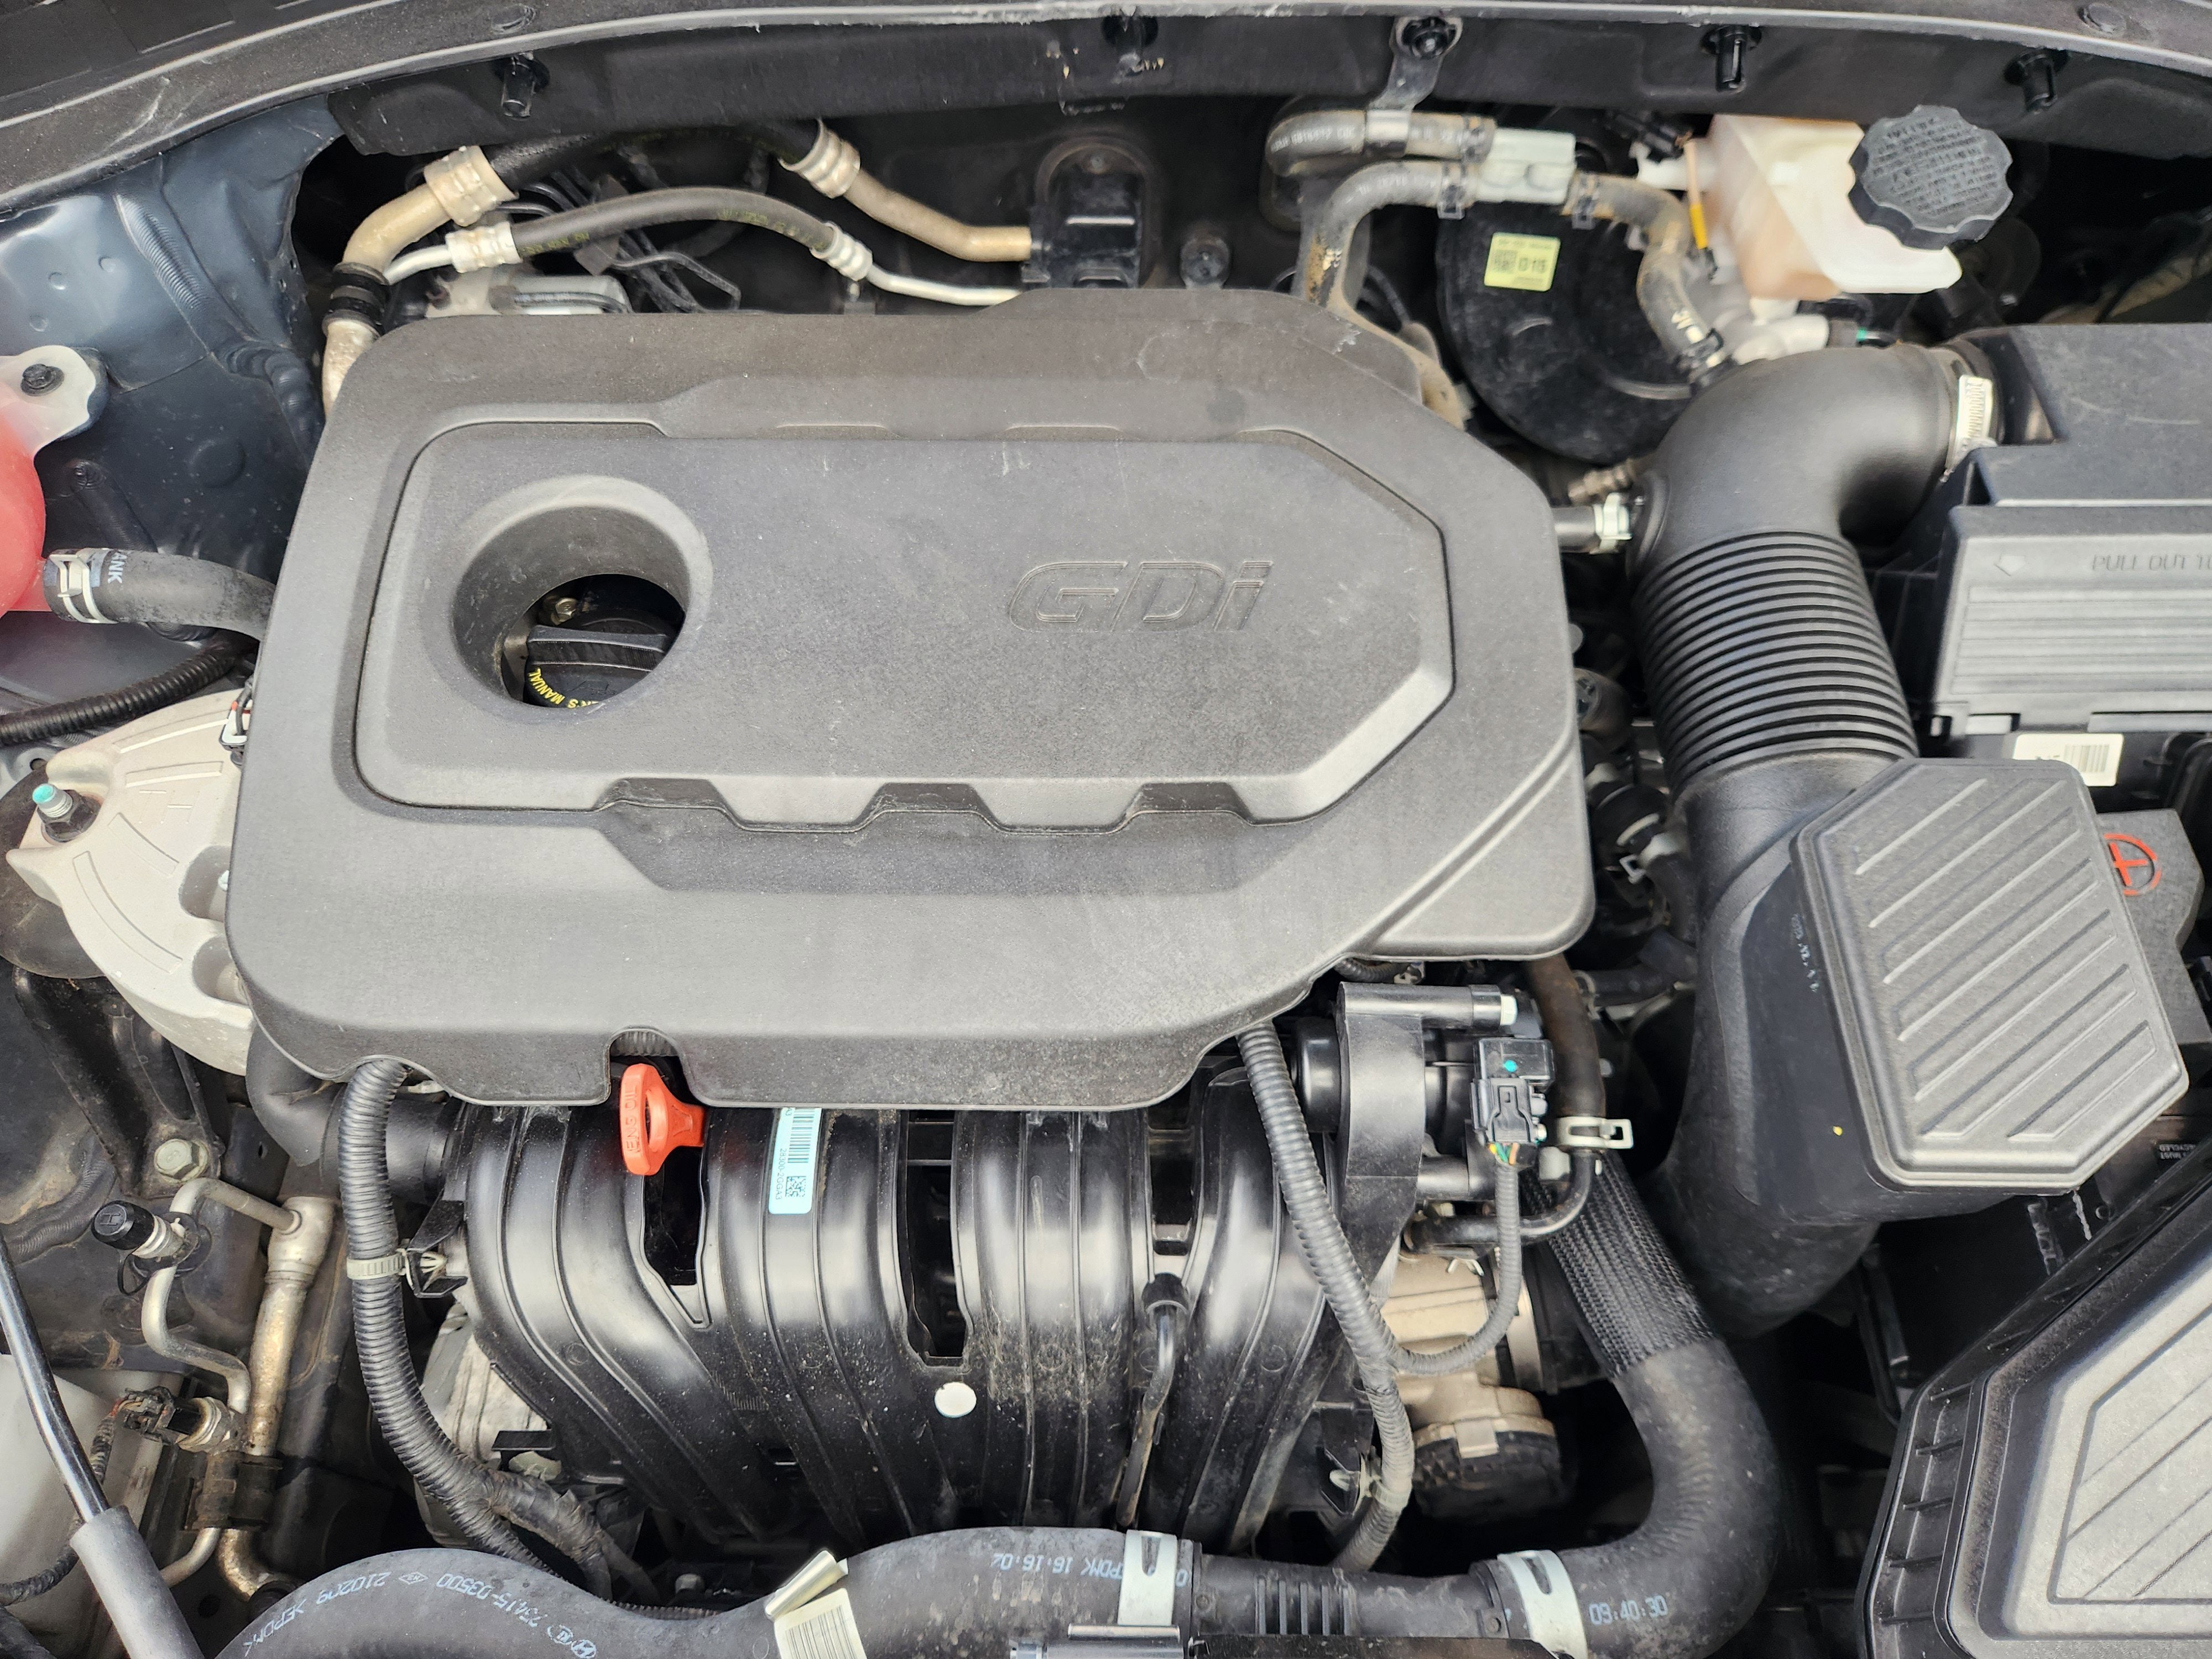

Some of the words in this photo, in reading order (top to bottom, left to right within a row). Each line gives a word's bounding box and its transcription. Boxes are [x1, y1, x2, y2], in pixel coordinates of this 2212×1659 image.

[2092, 554, 2143, 571] PULL
[2149, 554, 2190, 571] OUT
[1007, 560, 1274, 632] GDi
[527, 667, 565, 705] MANUAL
[625, 1084, 637, 1110] OIL
[625, 1115, 638, 1152] ENG
